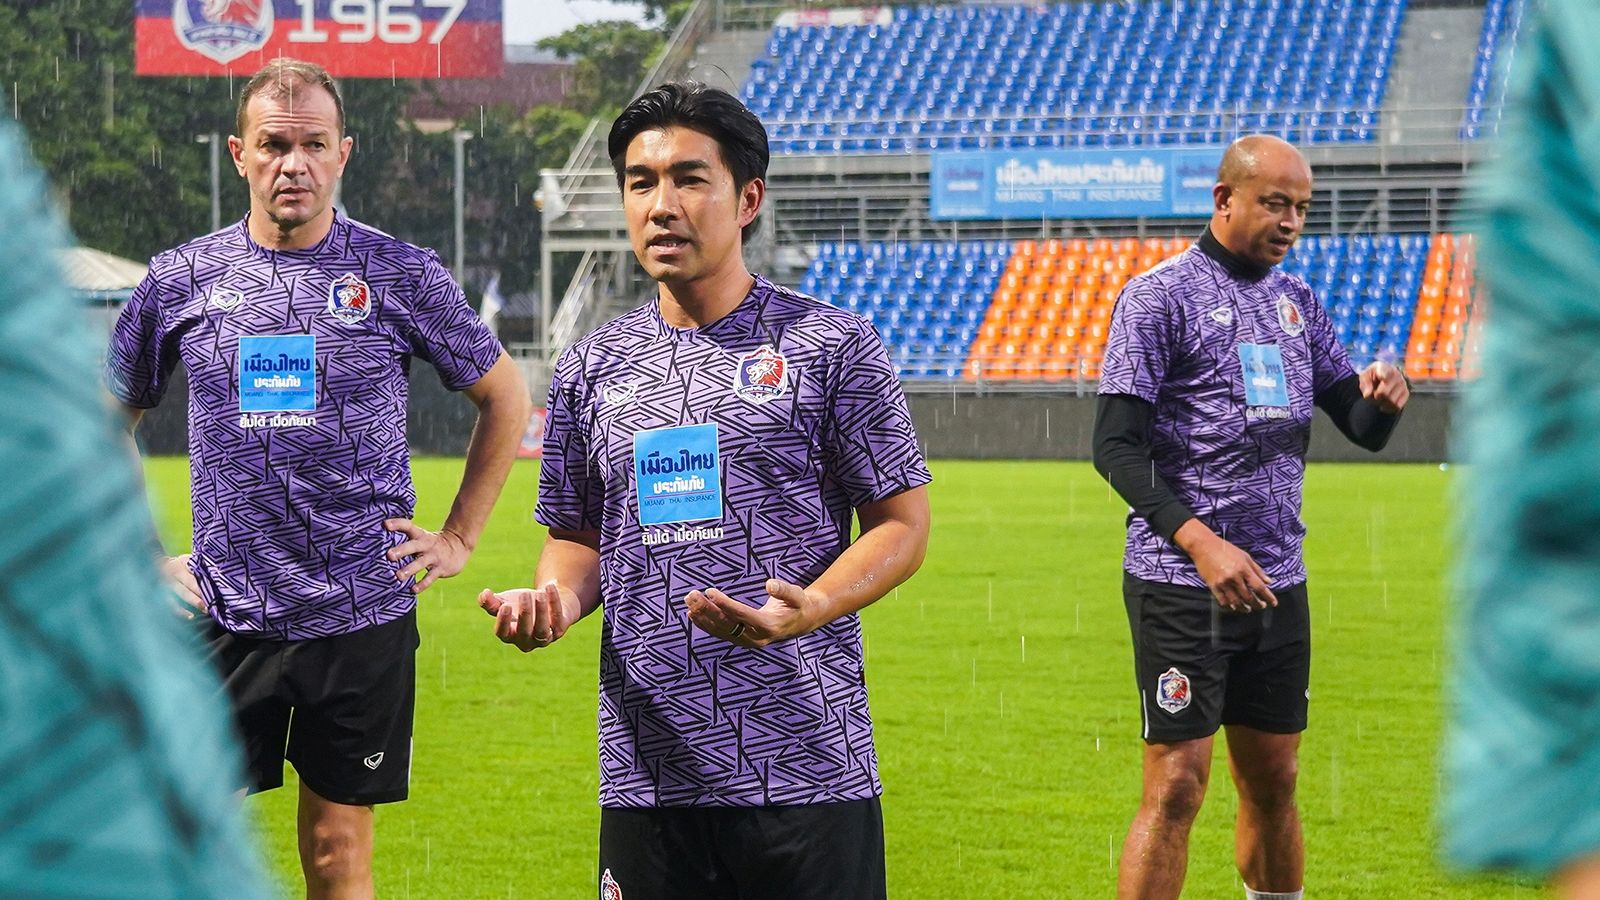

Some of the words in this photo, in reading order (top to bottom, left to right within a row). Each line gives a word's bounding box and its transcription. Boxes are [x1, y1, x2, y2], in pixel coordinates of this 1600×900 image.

[288, 0, 466, 44] 1967
[244, 353, 311, 373] เมืองไทย
[253, 374, 302, 388] ประกันภัย
[640, 449, 715, 476] เมืองไทย
[653, 475, 705, 494] ประกันภัย
[685, 494, 717, 503] INSURANCE
[642, 528, 670, 546] ยิ้มได้
[674, 524, 724, 543] เมื่อภัยมา
